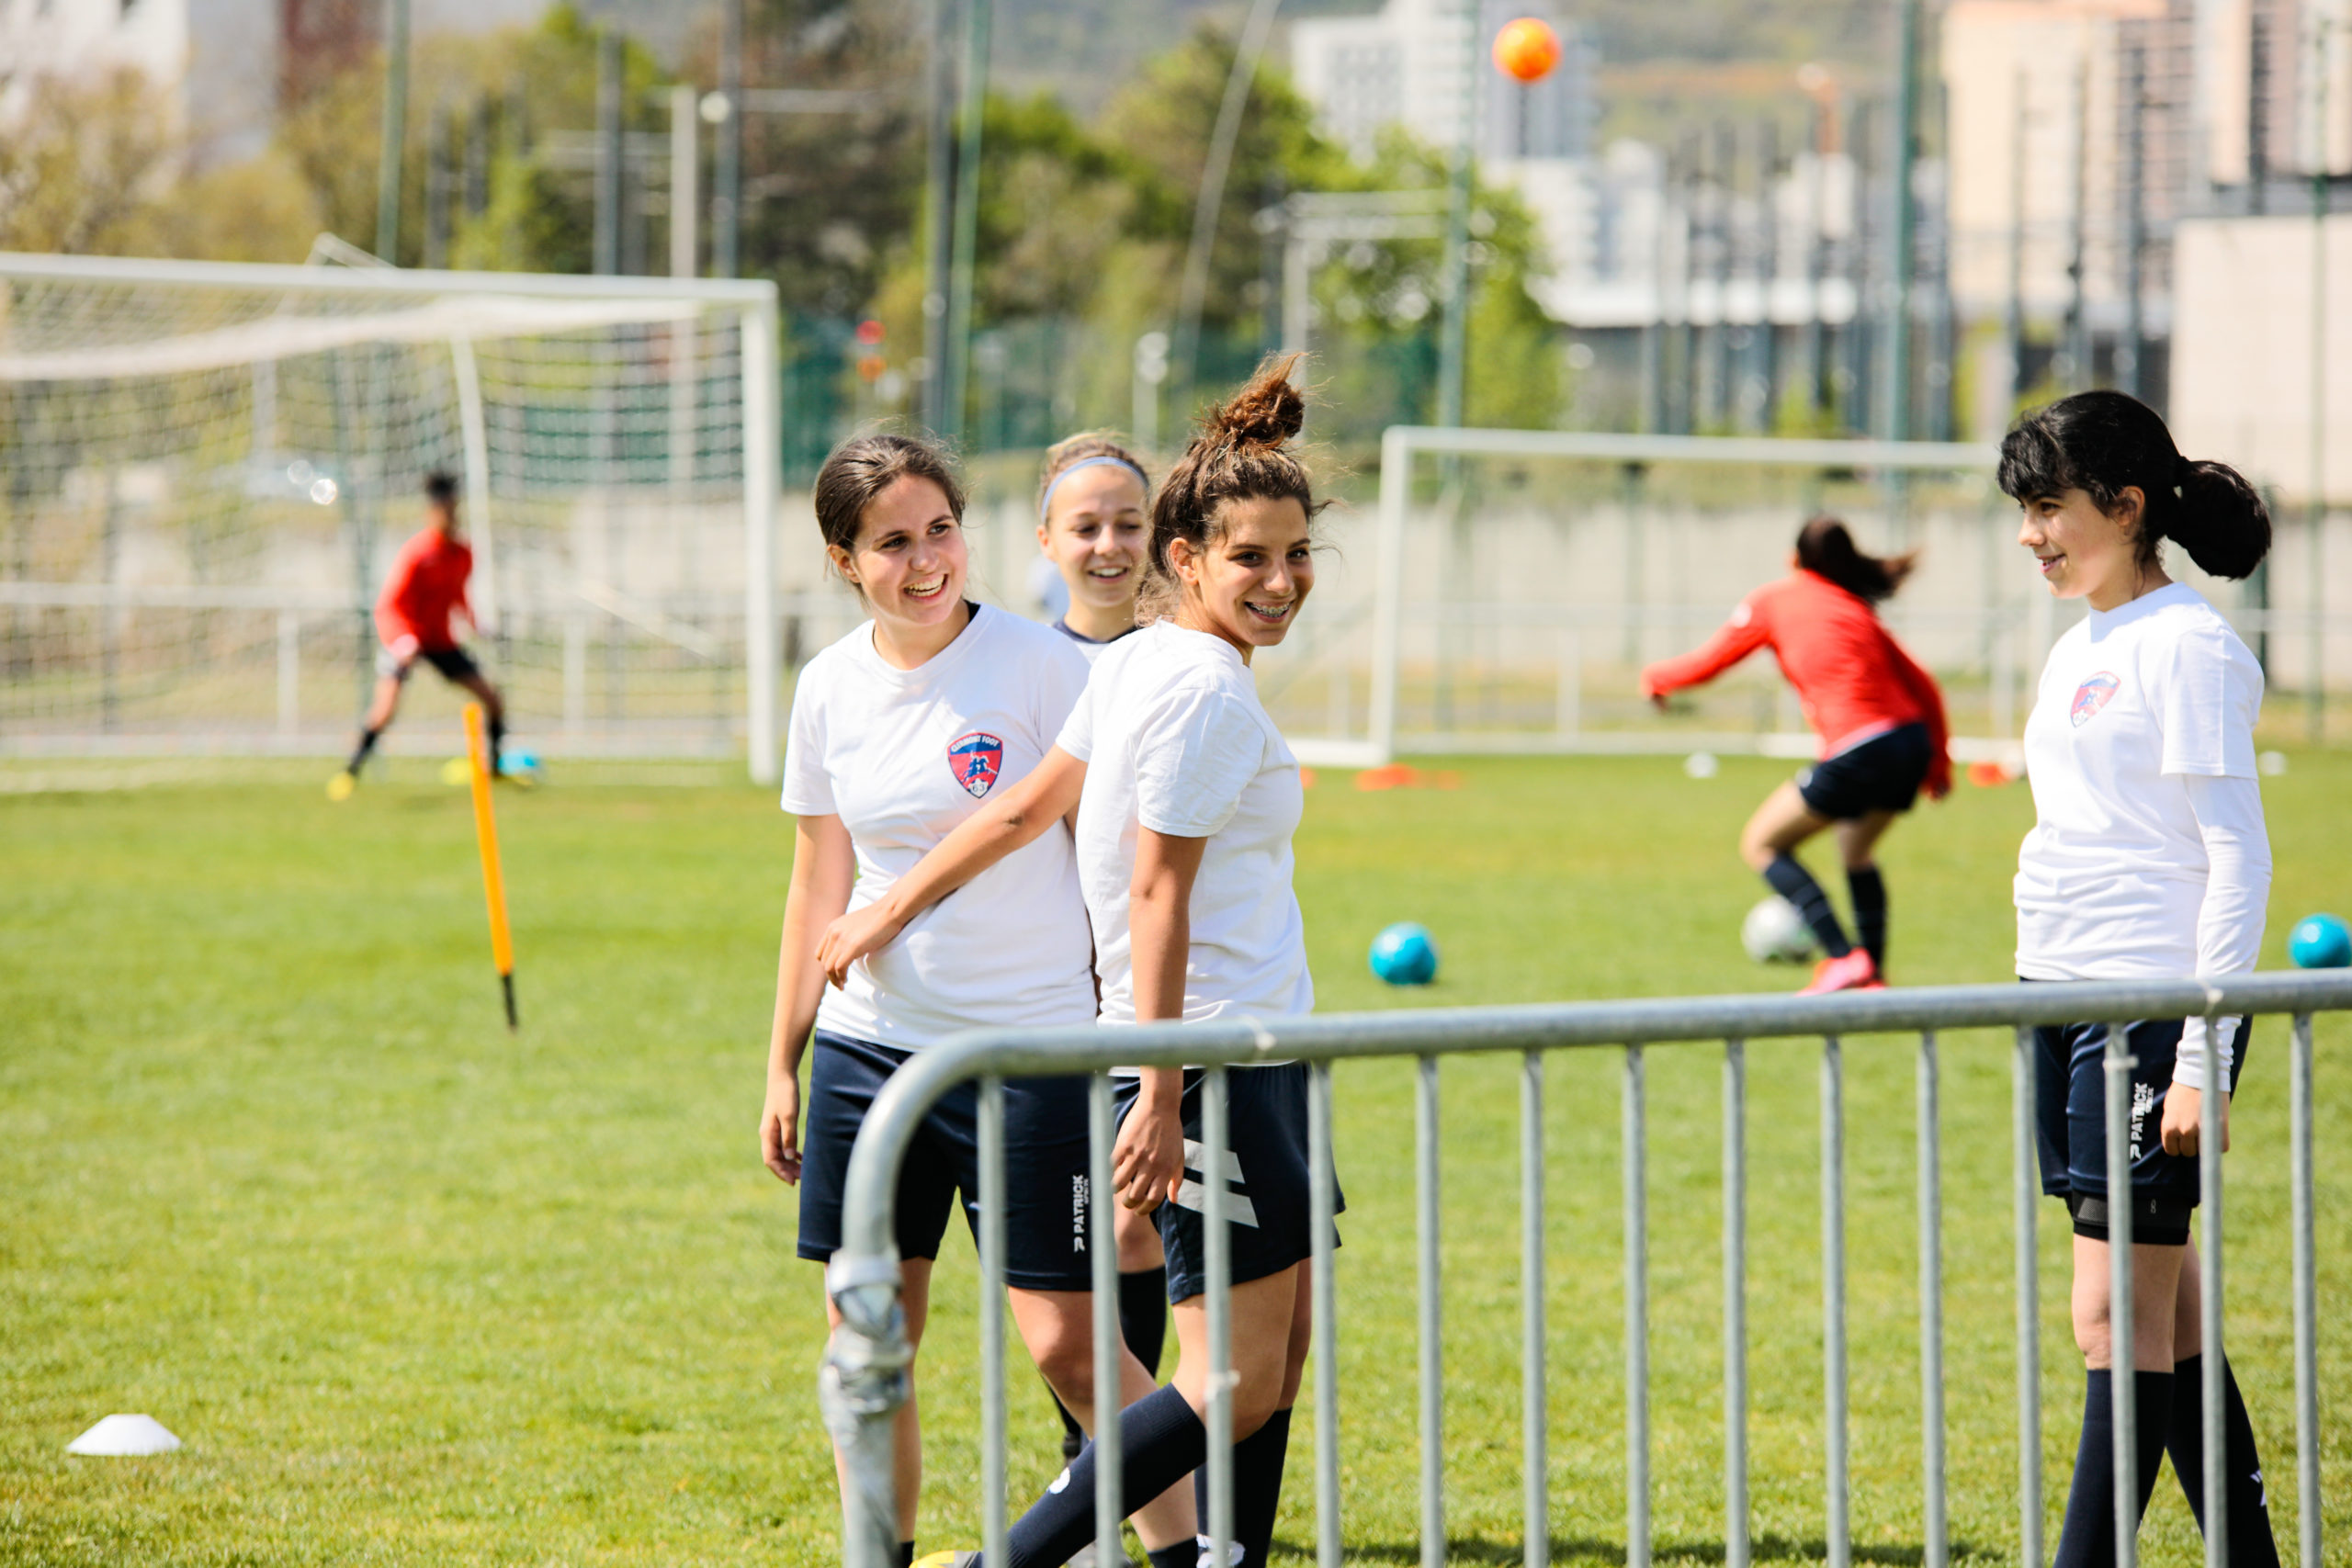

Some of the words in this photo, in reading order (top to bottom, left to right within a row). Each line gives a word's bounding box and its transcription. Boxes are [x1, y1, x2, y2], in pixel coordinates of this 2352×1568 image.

[982, 736, 999, 747] FOOT
[972, 784, 985, 792] 63
[2131, 1082, 2147, 1141] PATRICK
[1072, 1174, 1085, 1234] PATRICK
